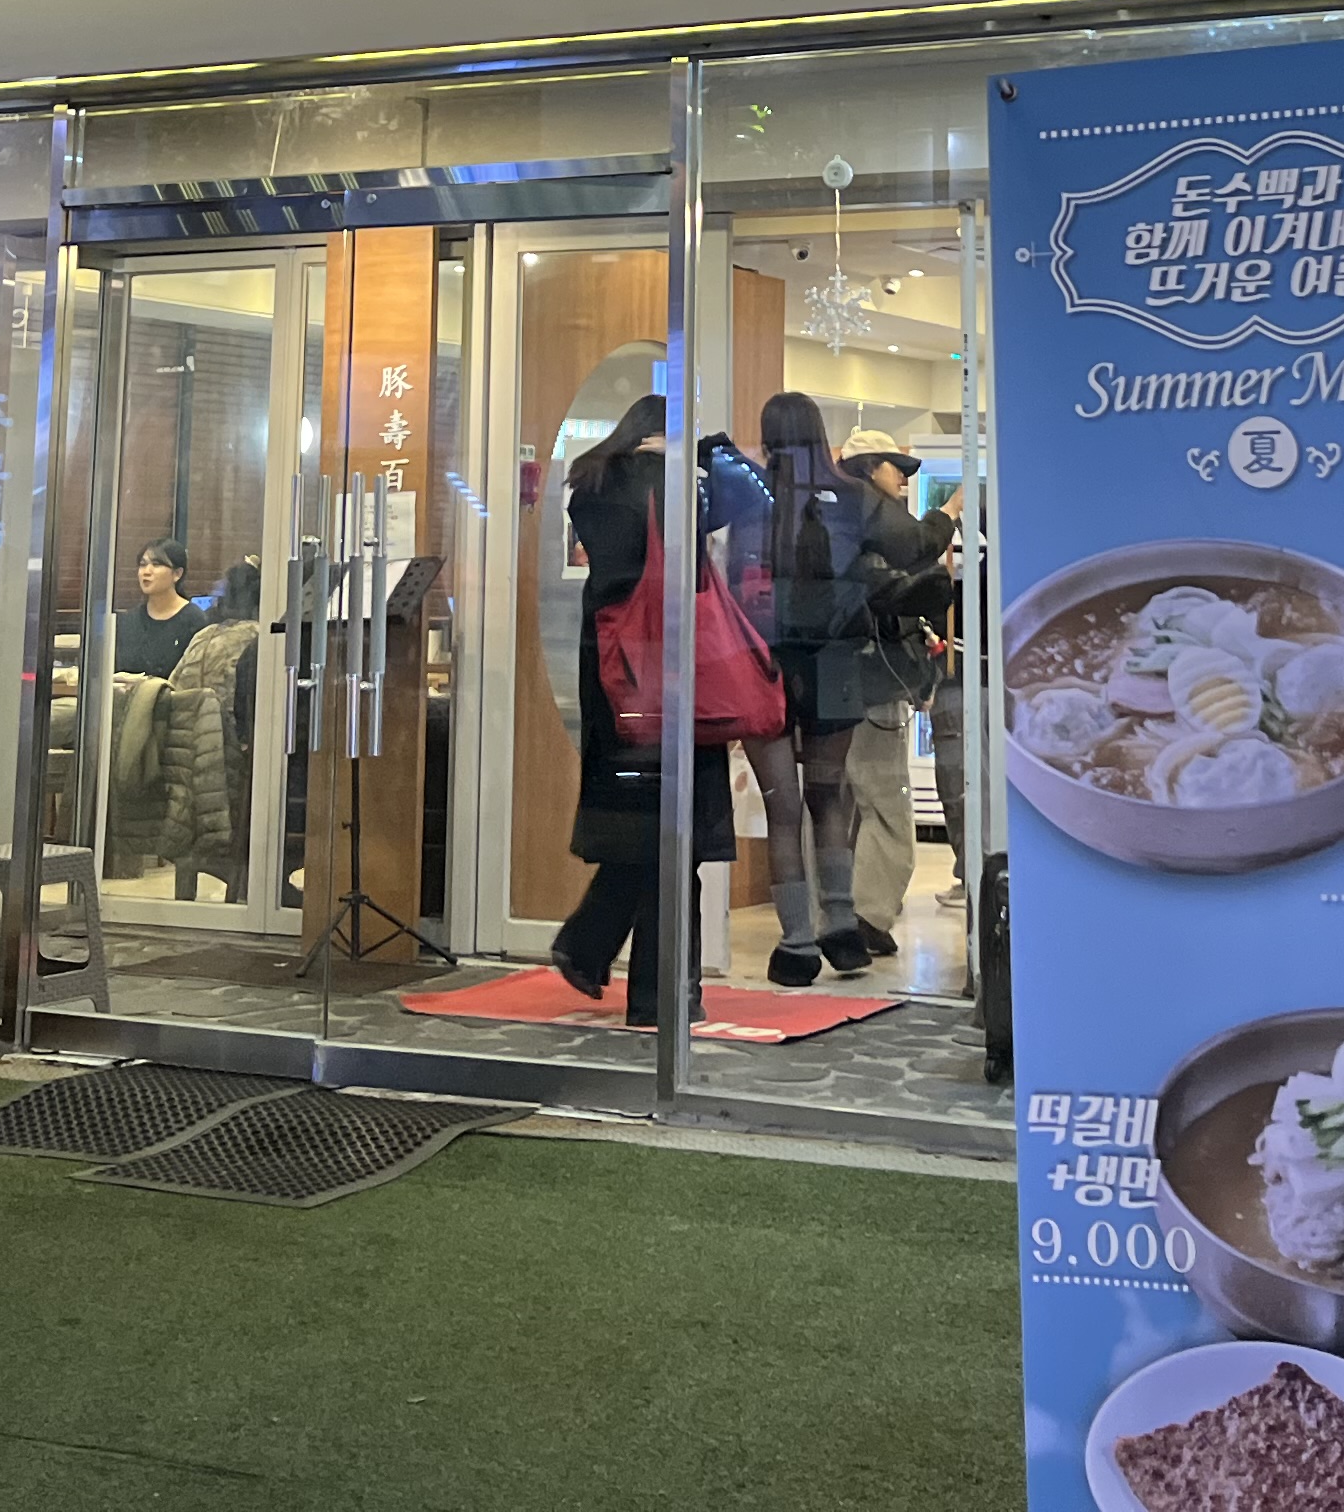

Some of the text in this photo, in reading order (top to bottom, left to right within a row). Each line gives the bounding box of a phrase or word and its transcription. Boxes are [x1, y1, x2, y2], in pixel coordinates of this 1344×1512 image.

[1171, 164, 1343, 218] 돈수백과
[1124, 220, 1209, 265] 함께
[1145, 257, 1272, 307] 뜨거운
[1075, 361, 1286, 419] Summer
[1241, 429, 1285, 475] 夏
[1027, 1093, 1159, 1147] 떡갈비
[1047, 1158, 1160, 1209] +냉면
[1031, 1217, 1197, 1274] 9.000
